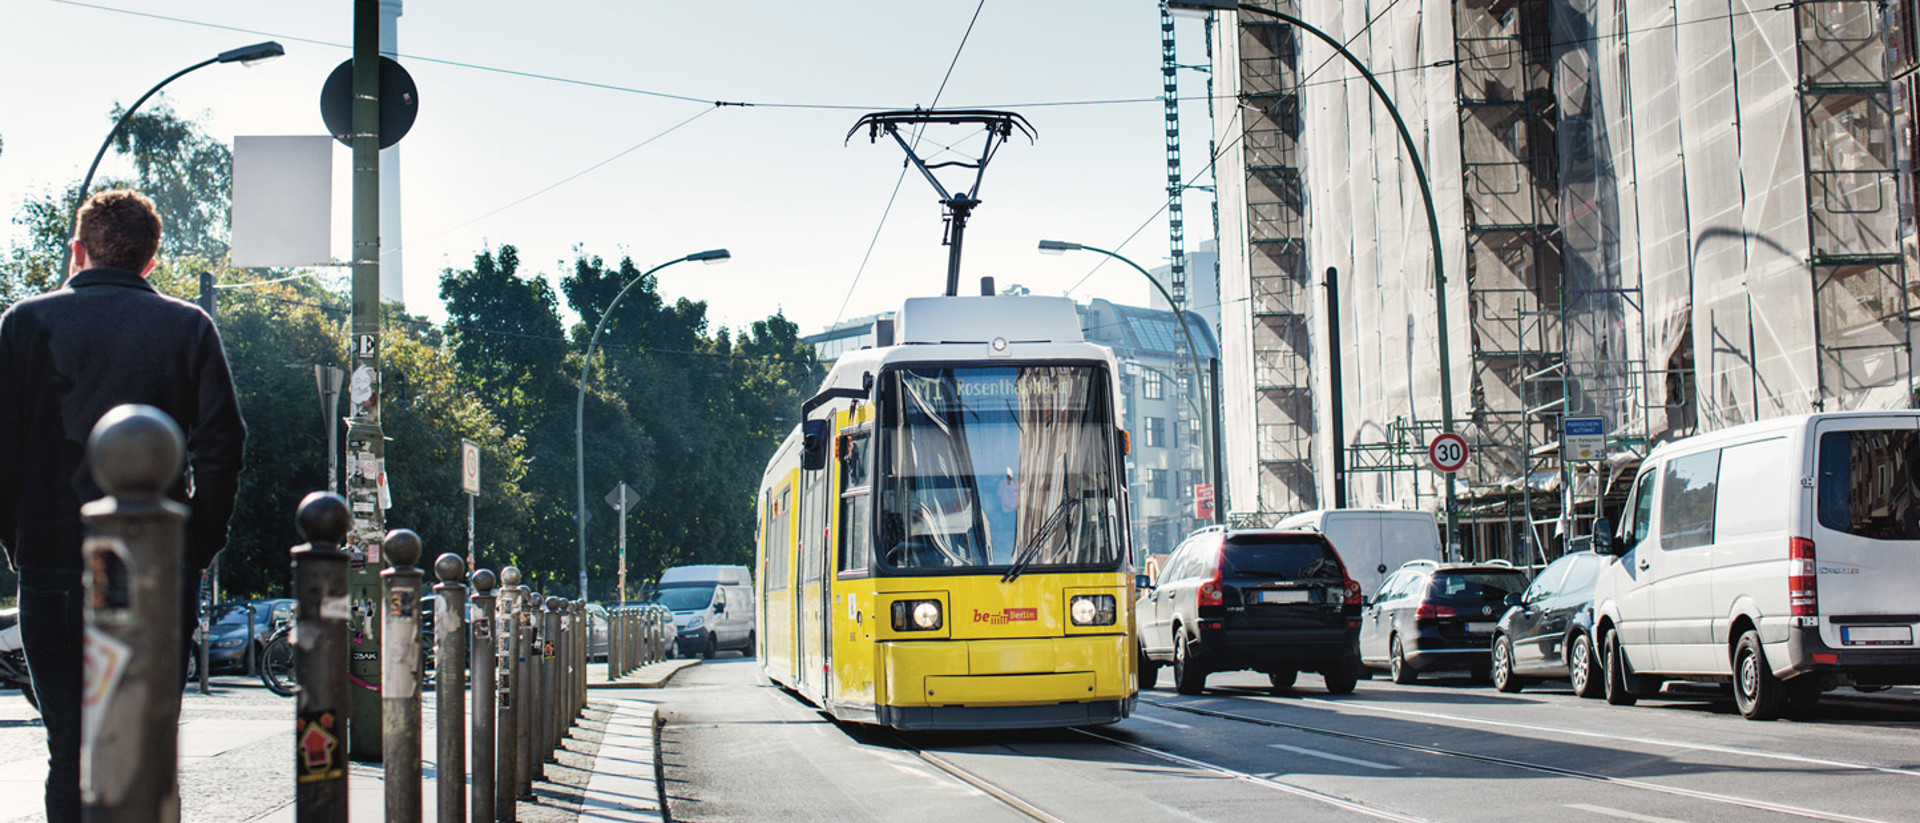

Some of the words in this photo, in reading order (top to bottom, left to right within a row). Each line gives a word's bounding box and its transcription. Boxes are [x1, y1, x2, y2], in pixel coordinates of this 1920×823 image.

[1438, 443, 1461, 462] 30
[973, 609, 990, 623] be
[1010, 610, 1035, 620] Berlin
